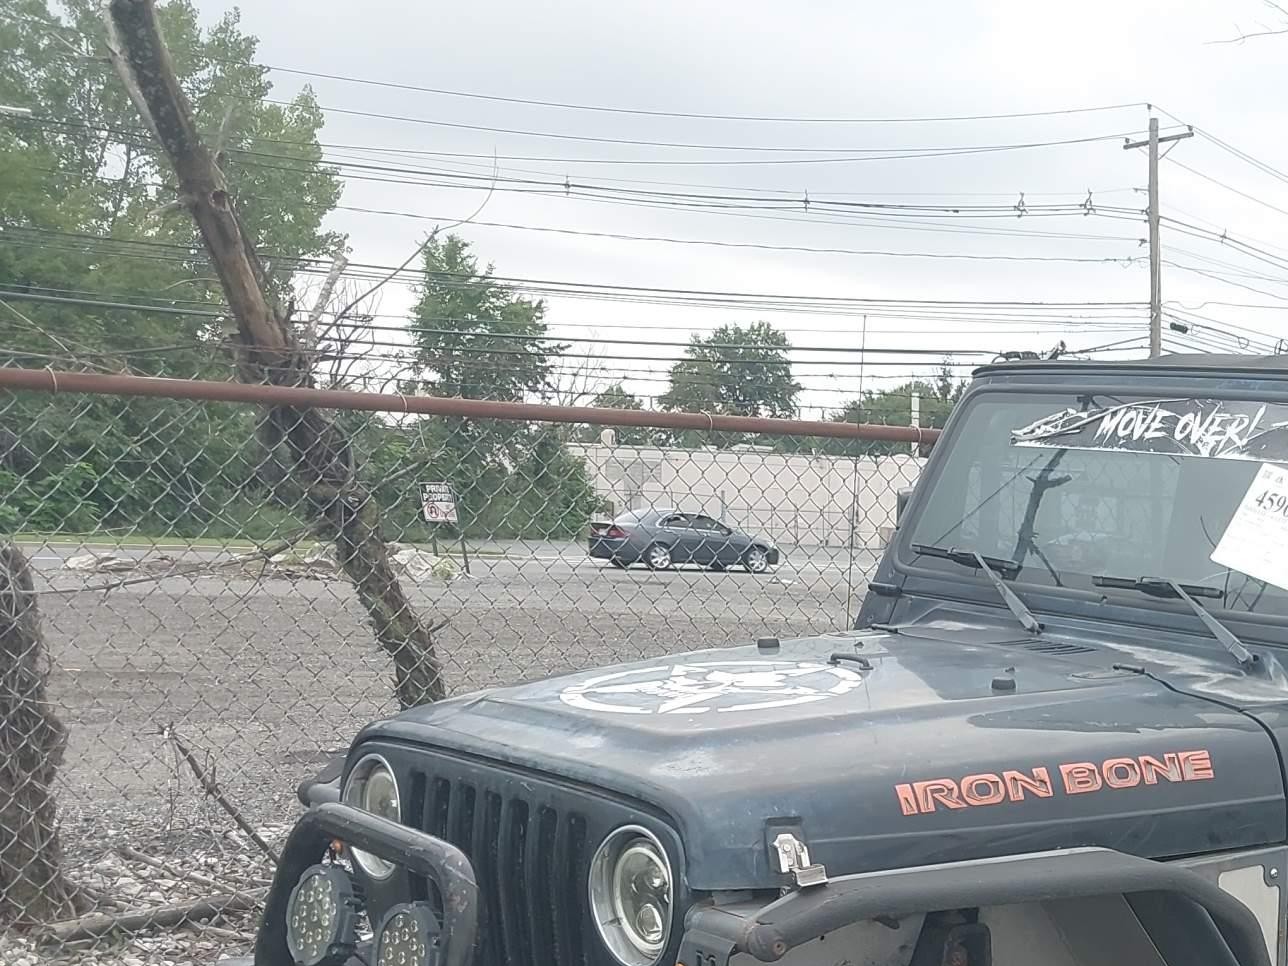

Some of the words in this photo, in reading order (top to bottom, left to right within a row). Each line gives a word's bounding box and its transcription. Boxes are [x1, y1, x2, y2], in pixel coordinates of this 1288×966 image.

[1093, 403, 1174, 445] MOVE
[1174, 403, 1267, 456] OVER!
[425, 484, 450, 493] PRIV
[895, 766, 1054, 817] IRON
[1058, 749, 1215, 796] BONE
